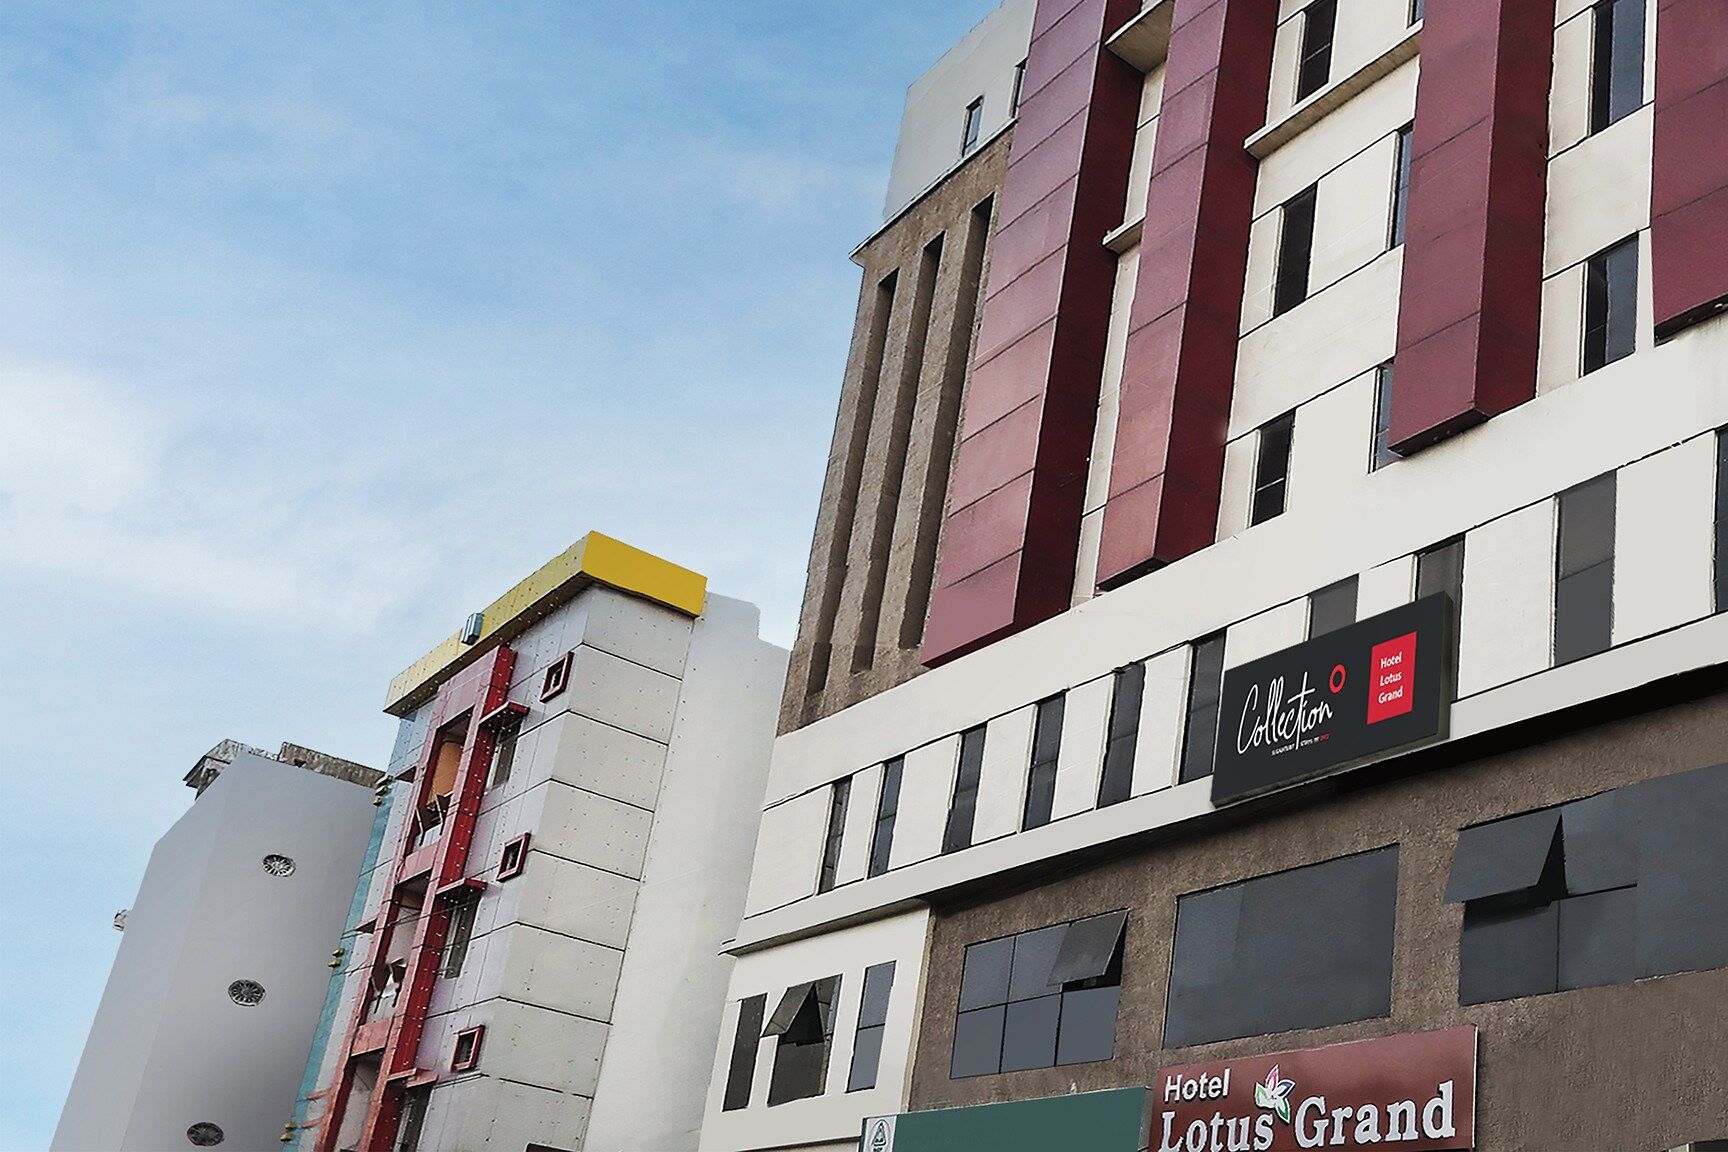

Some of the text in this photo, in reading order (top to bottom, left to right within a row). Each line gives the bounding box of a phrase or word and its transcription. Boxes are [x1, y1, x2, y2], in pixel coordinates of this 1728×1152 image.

[1380, 651, 1402, 669] Hotel
[1380, 672, 1402, 687] Lotus
[1378, 685, 1403, 704] Grand
[1237, 671, 1333, 755] Collection
[1164, 1068, 1230, 1102] Hotel
[1158, 1080, 1456, 1152] Lotus Grand
